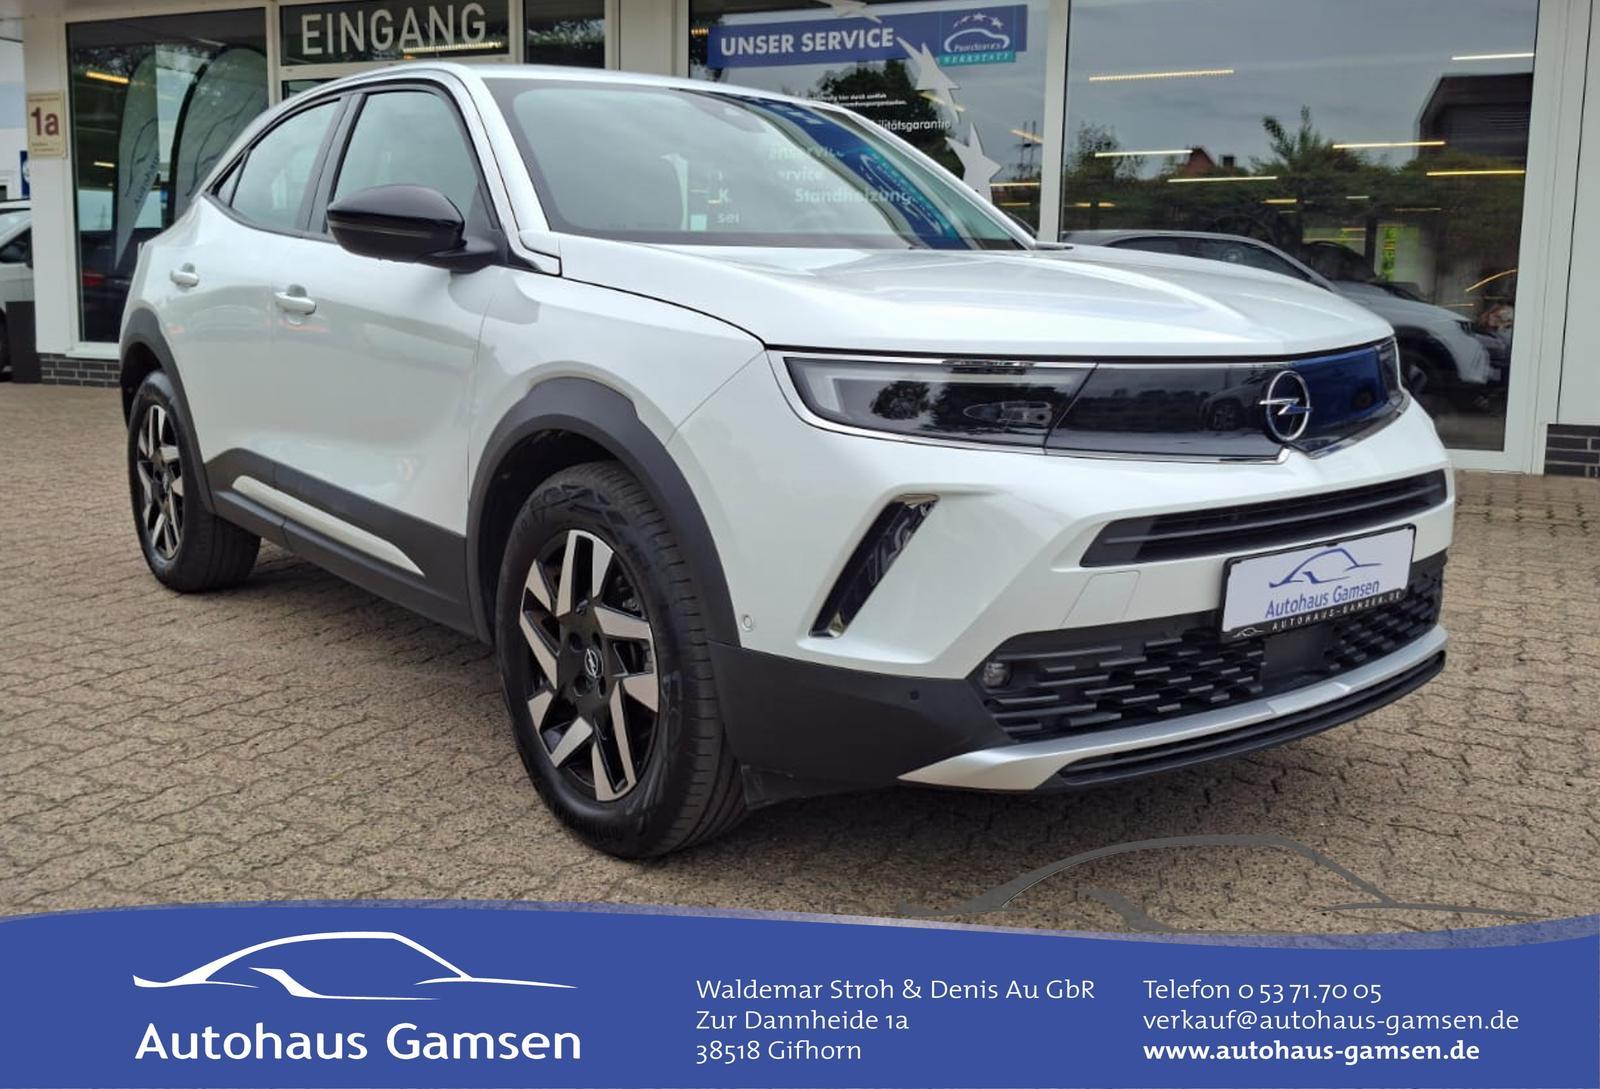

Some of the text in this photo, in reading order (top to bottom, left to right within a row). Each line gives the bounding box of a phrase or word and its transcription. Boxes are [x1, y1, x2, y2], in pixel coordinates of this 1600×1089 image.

[301, 2, 486, 55] EINGANG
[720, 27, 894, 56] UNSER SERVICE
[31, 106, 60, 136] 1a
[1265, 580, 1380, 619] Autohaus Gamsen
